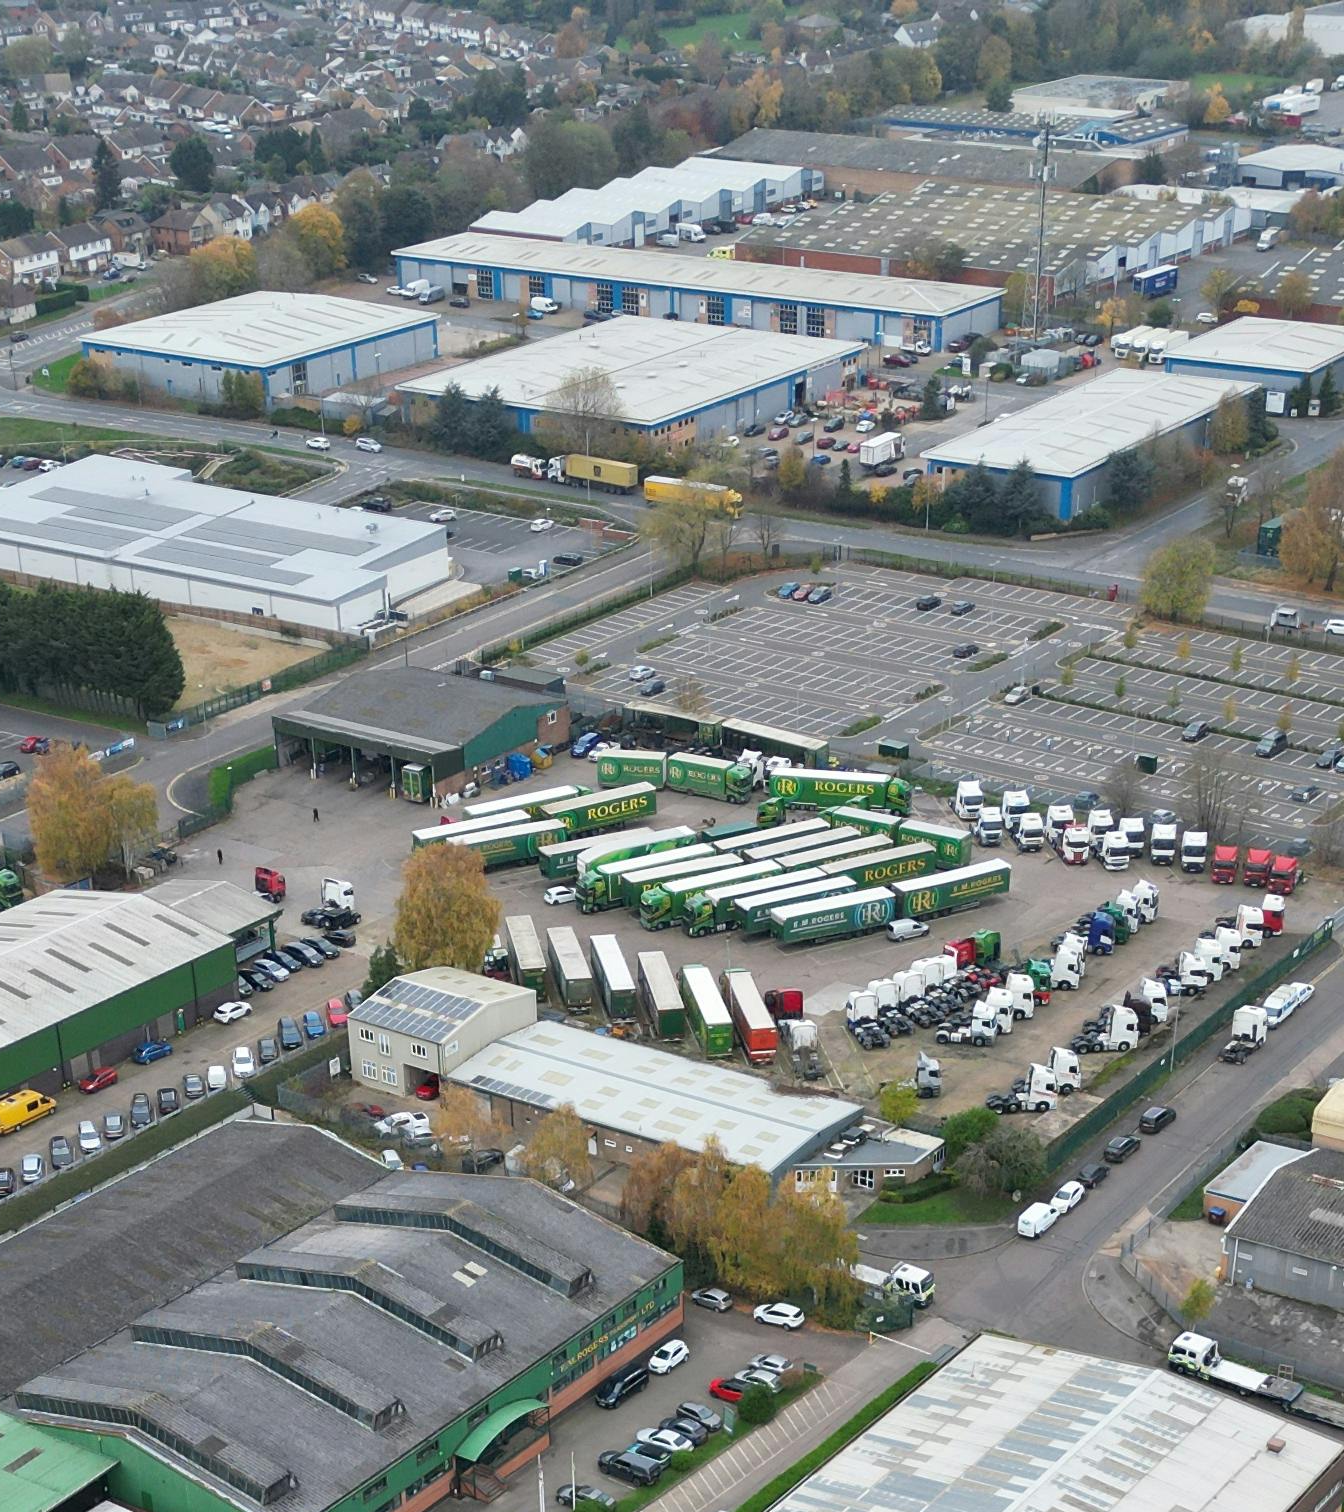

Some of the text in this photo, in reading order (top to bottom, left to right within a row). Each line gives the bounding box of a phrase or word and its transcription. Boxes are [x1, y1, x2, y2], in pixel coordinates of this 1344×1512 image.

[813, 780, 875, 796] ROGERS
[587, 795, 648, 820] ROGERS
[863, 858, 926, 883] ROGERS
